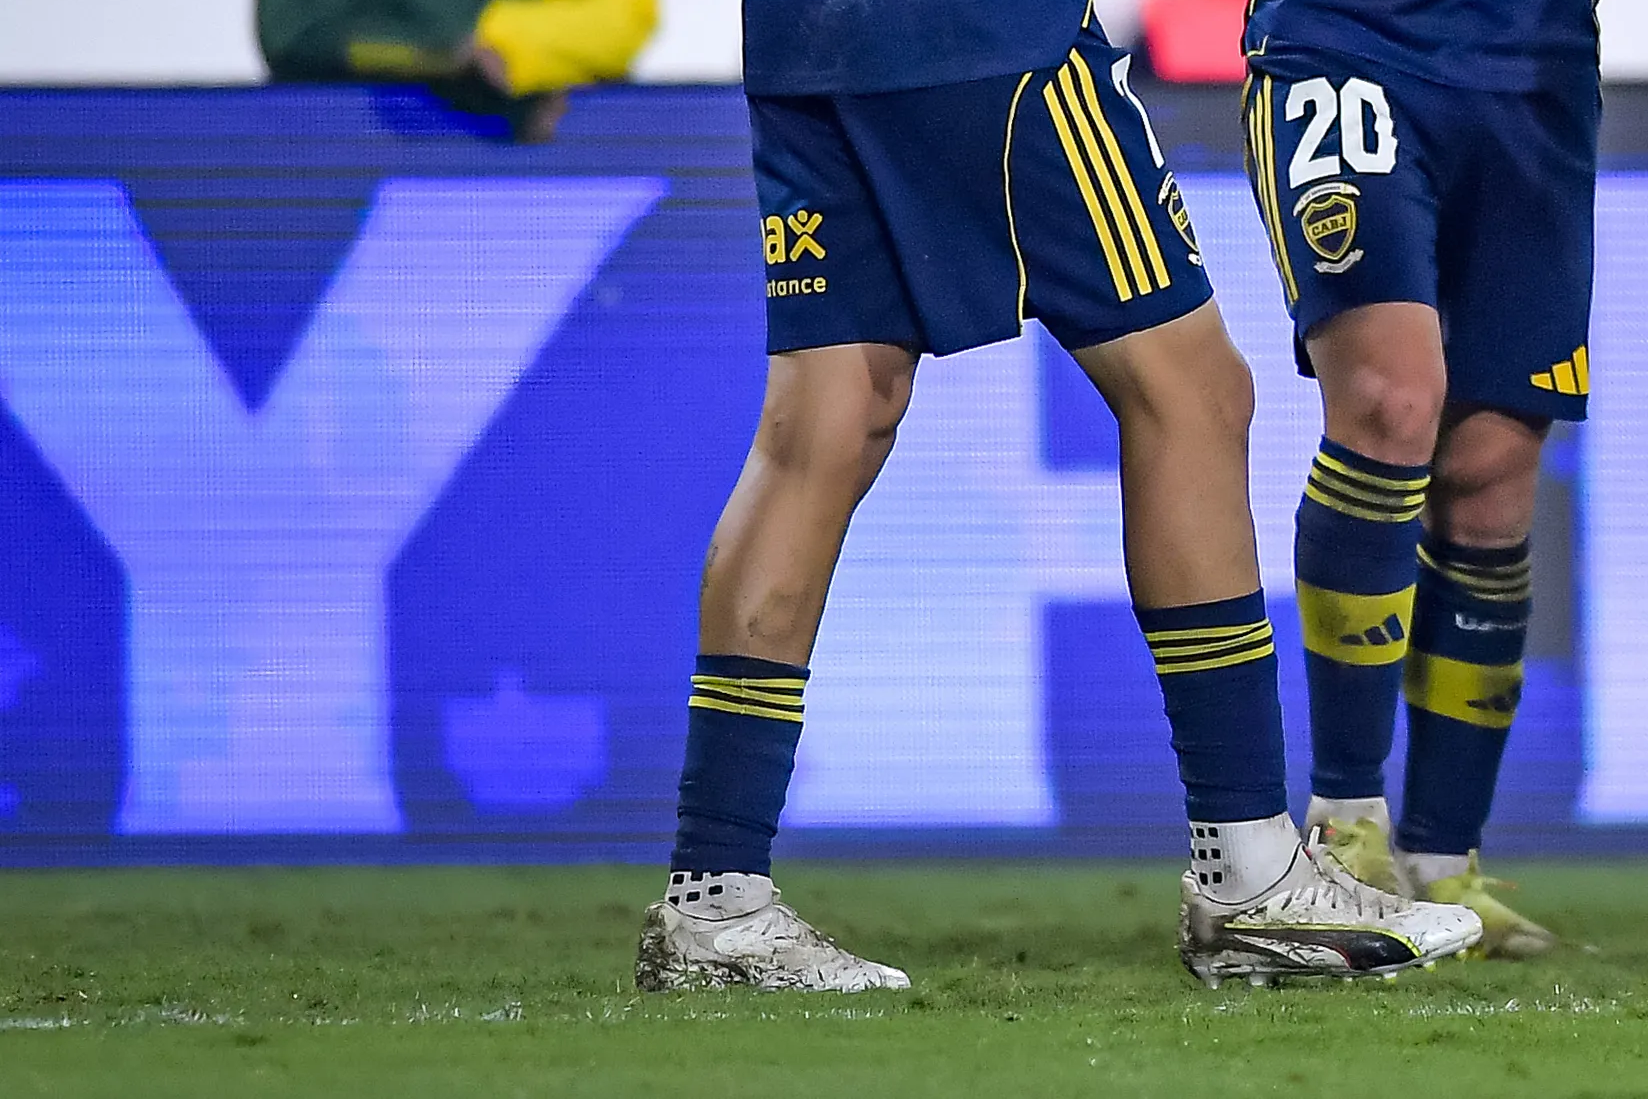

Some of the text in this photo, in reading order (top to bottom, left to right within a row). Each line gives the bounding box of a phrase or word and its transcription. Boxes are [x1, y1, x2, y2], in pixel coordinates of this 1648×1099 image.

[1285, 77, 1398, 190] 20
[761, 210, 827, 265] ax
[1311, 216, 1349, 237] CABJ
